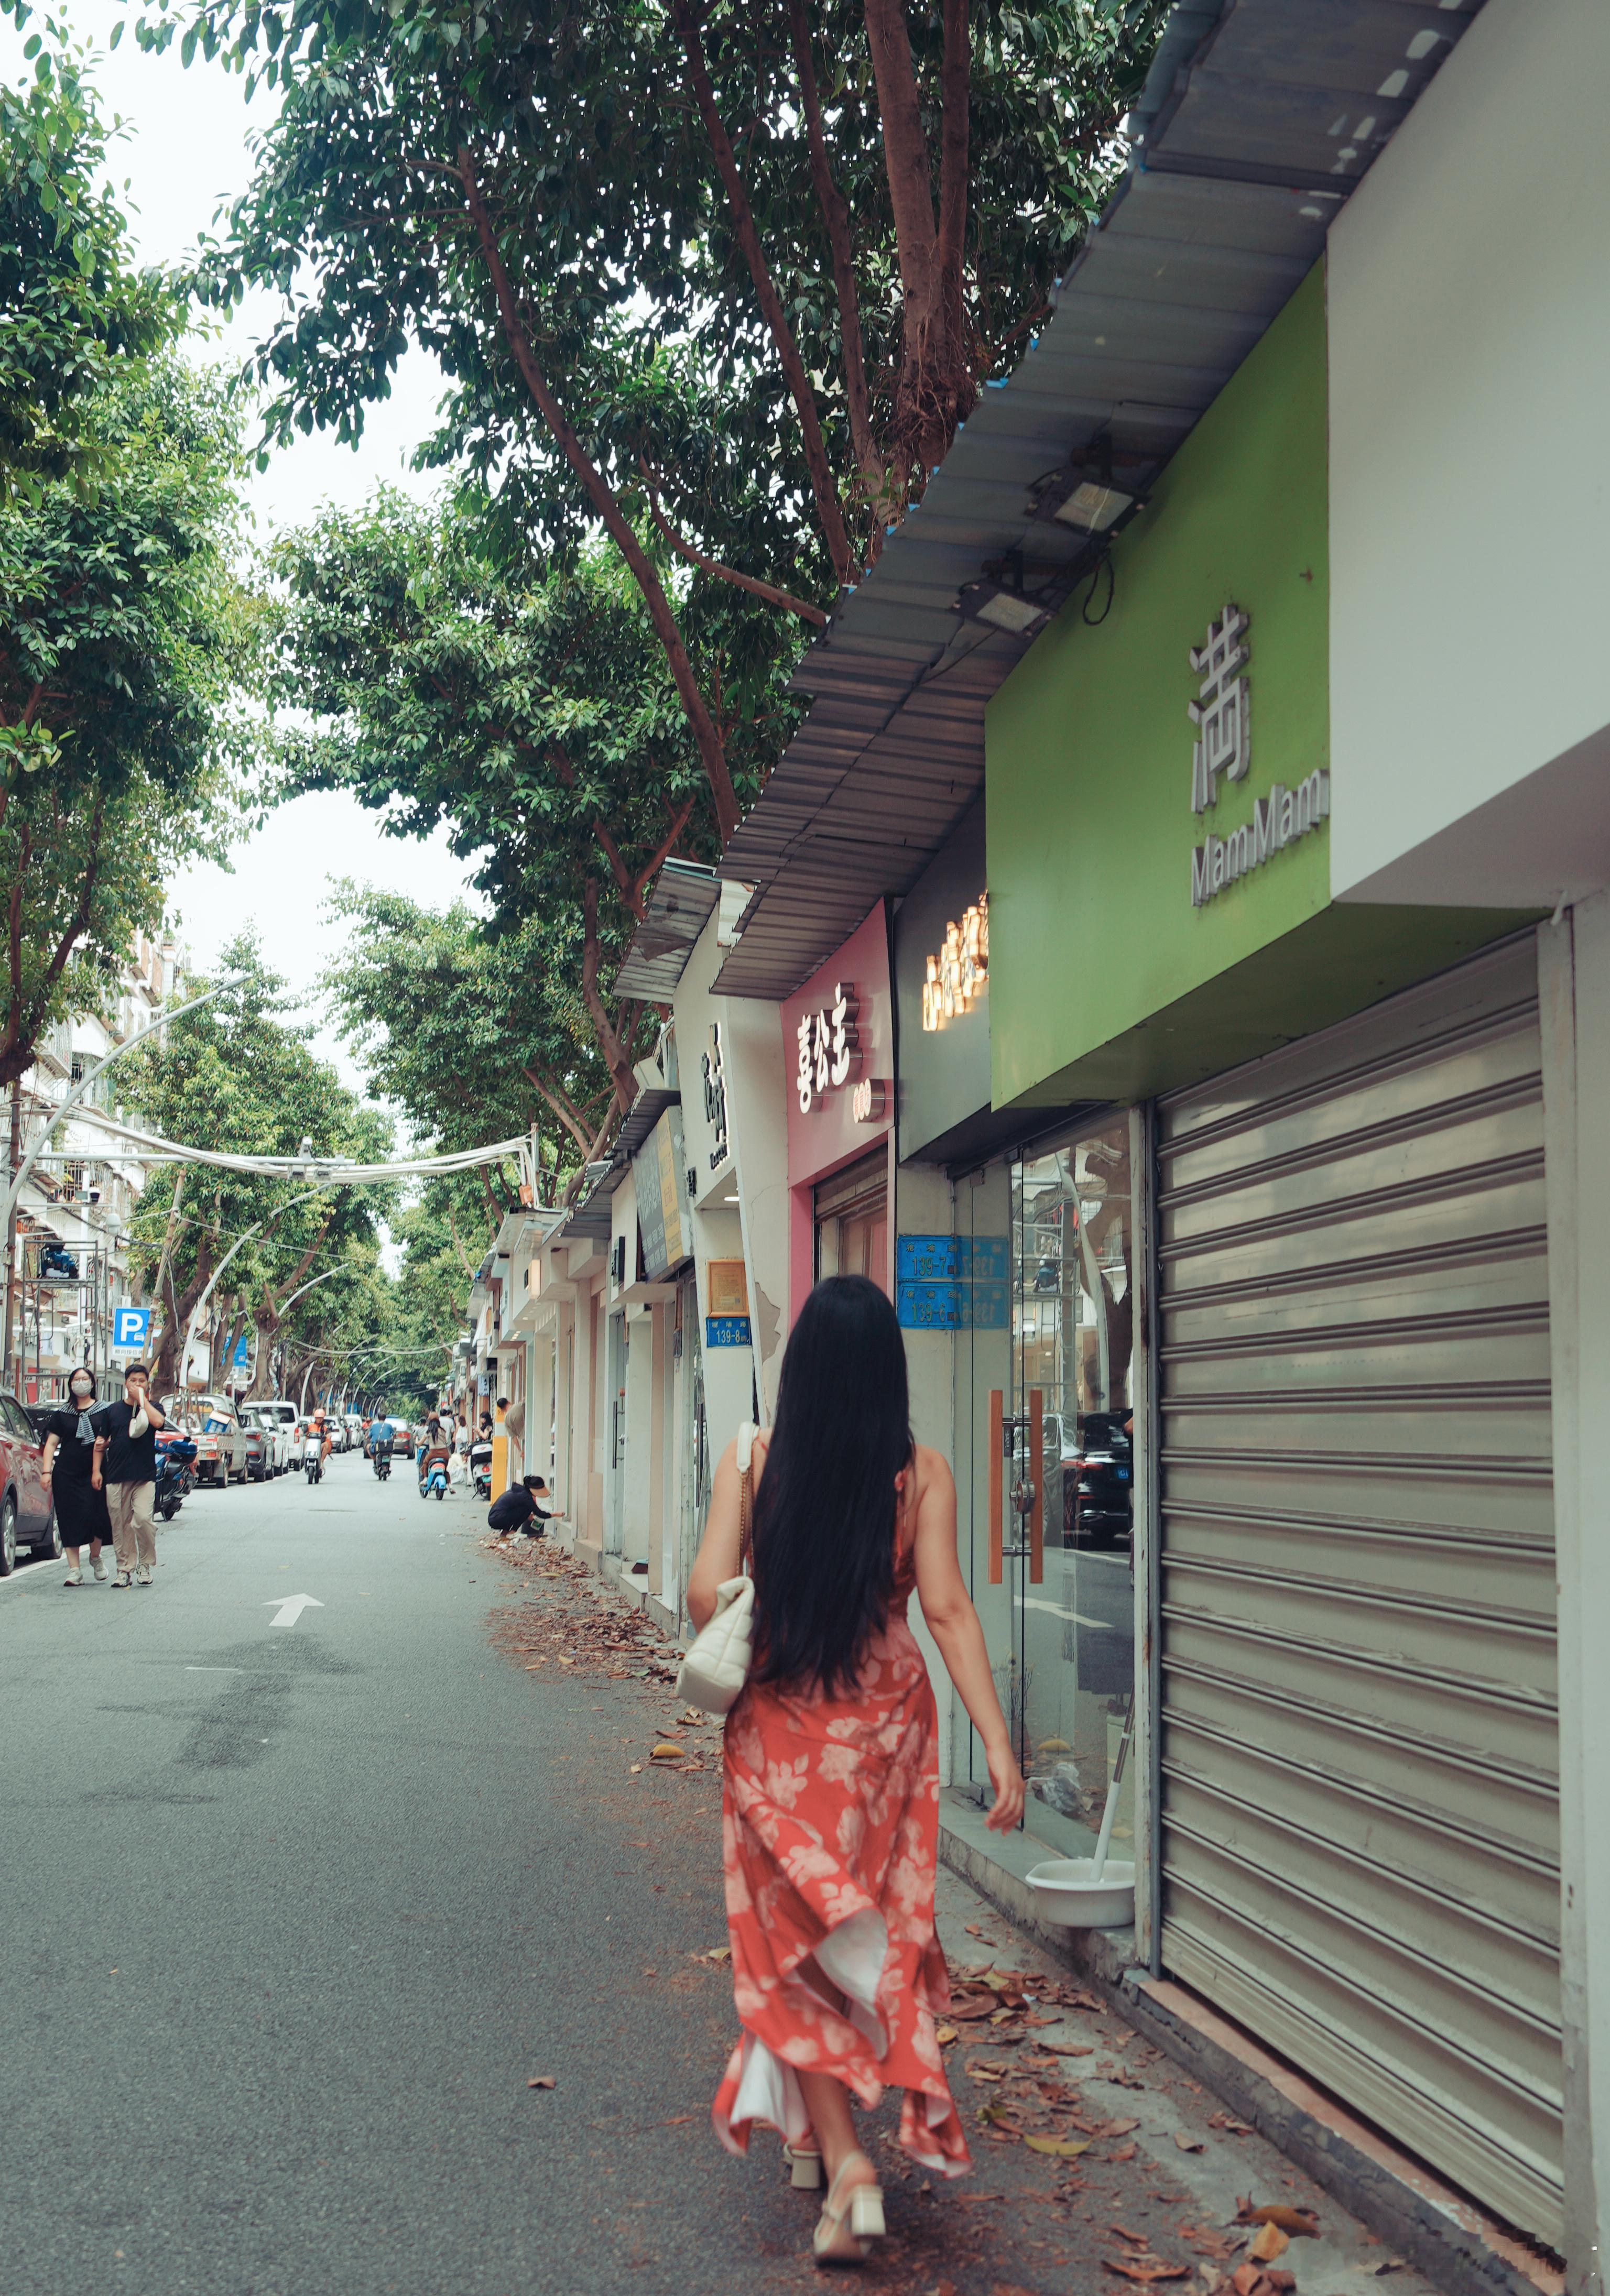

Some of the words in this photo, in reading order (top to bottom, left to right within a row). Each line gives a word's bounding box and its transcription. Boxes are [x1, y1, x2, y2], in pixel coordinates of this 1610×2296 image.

[1191, 768, 1328, 906] MamMam
[912, 1256, 946, 1276] 139-7
[912, 1303, 945, 1322] 139-6
[120, 1313, 143, 1342] P
[716, 1329, 740, 1343] 139-8
